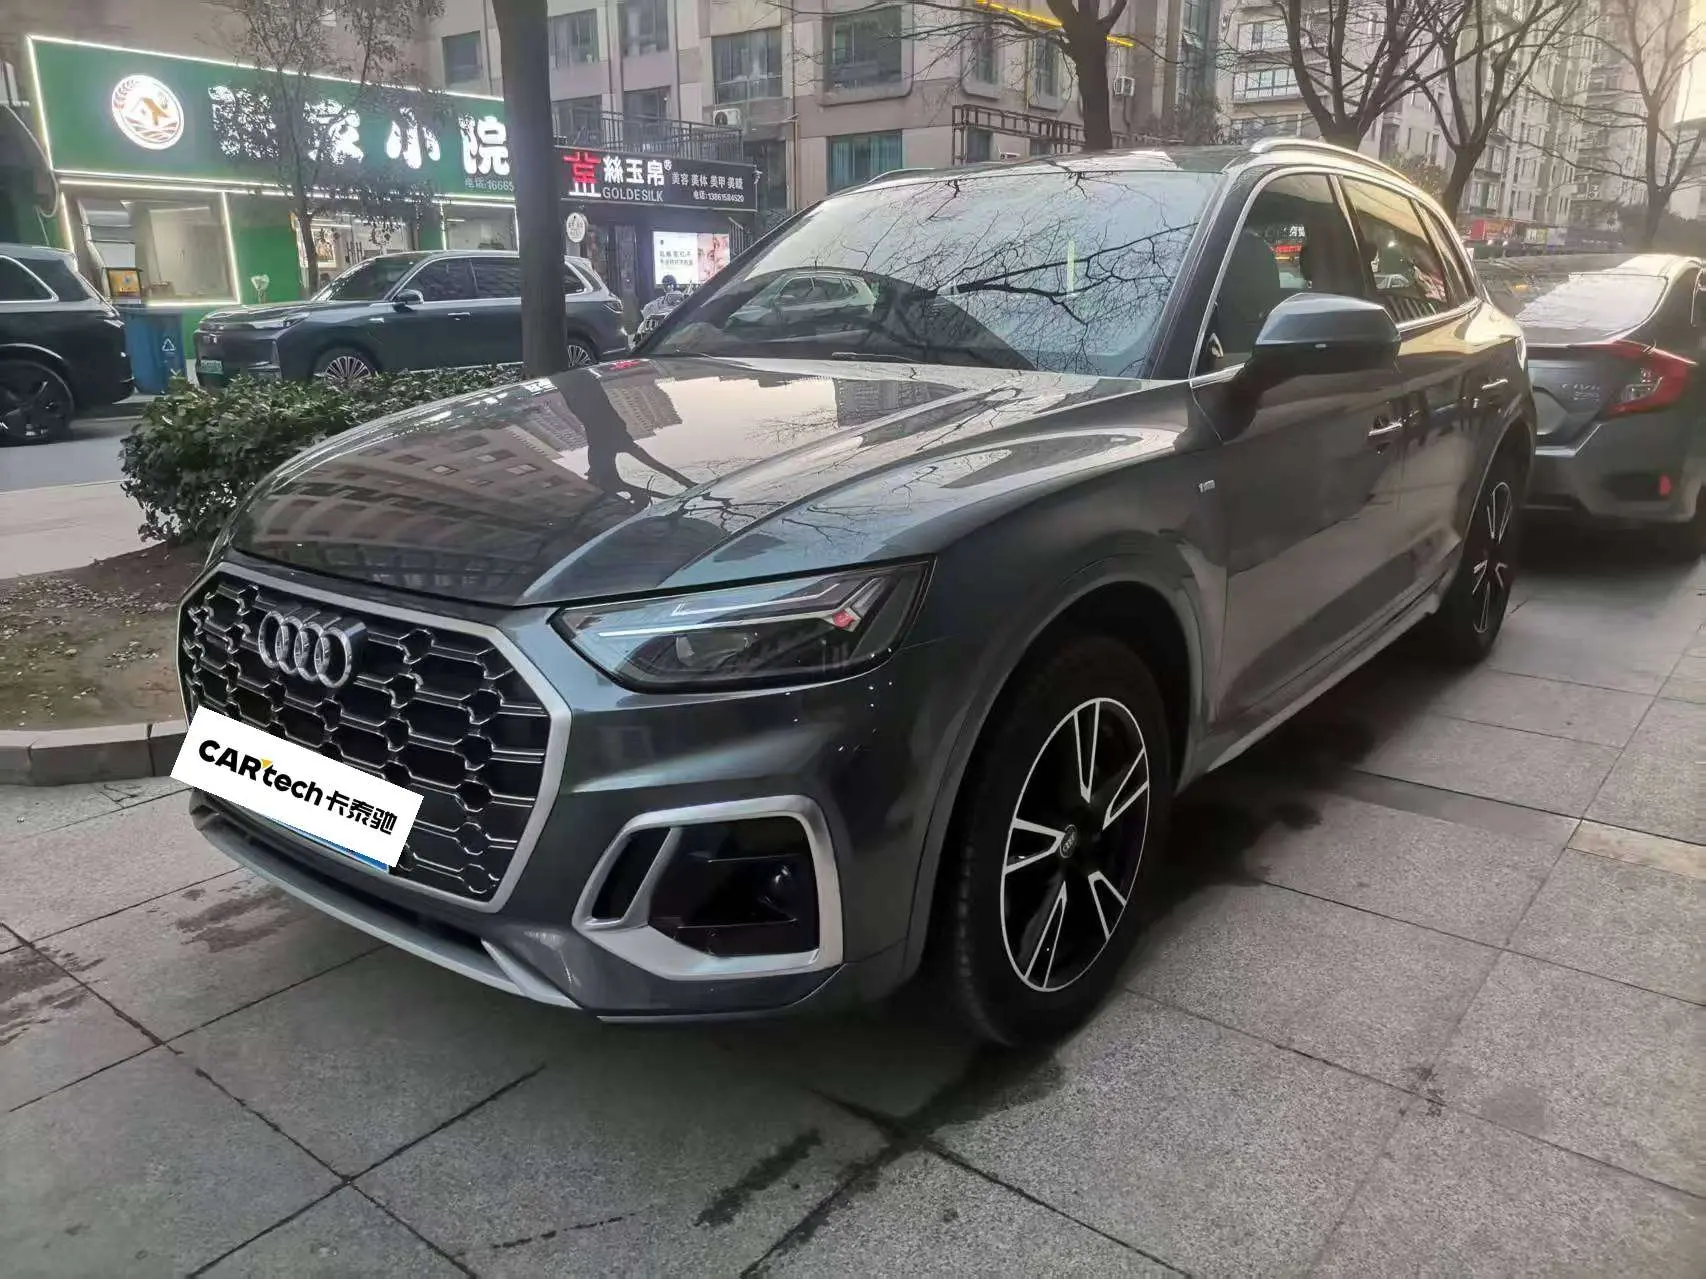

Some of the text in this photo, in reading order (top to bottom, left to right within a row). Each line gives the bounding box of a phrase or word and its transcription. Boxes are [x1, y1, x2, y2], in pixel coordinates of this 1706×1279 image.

[671, 171, 689, 186] 美容
[691, 173, 708, 187] 美体
[710, 175, 726, 188] 美甲
[602, 186, 664, 203] GOLDESILK
